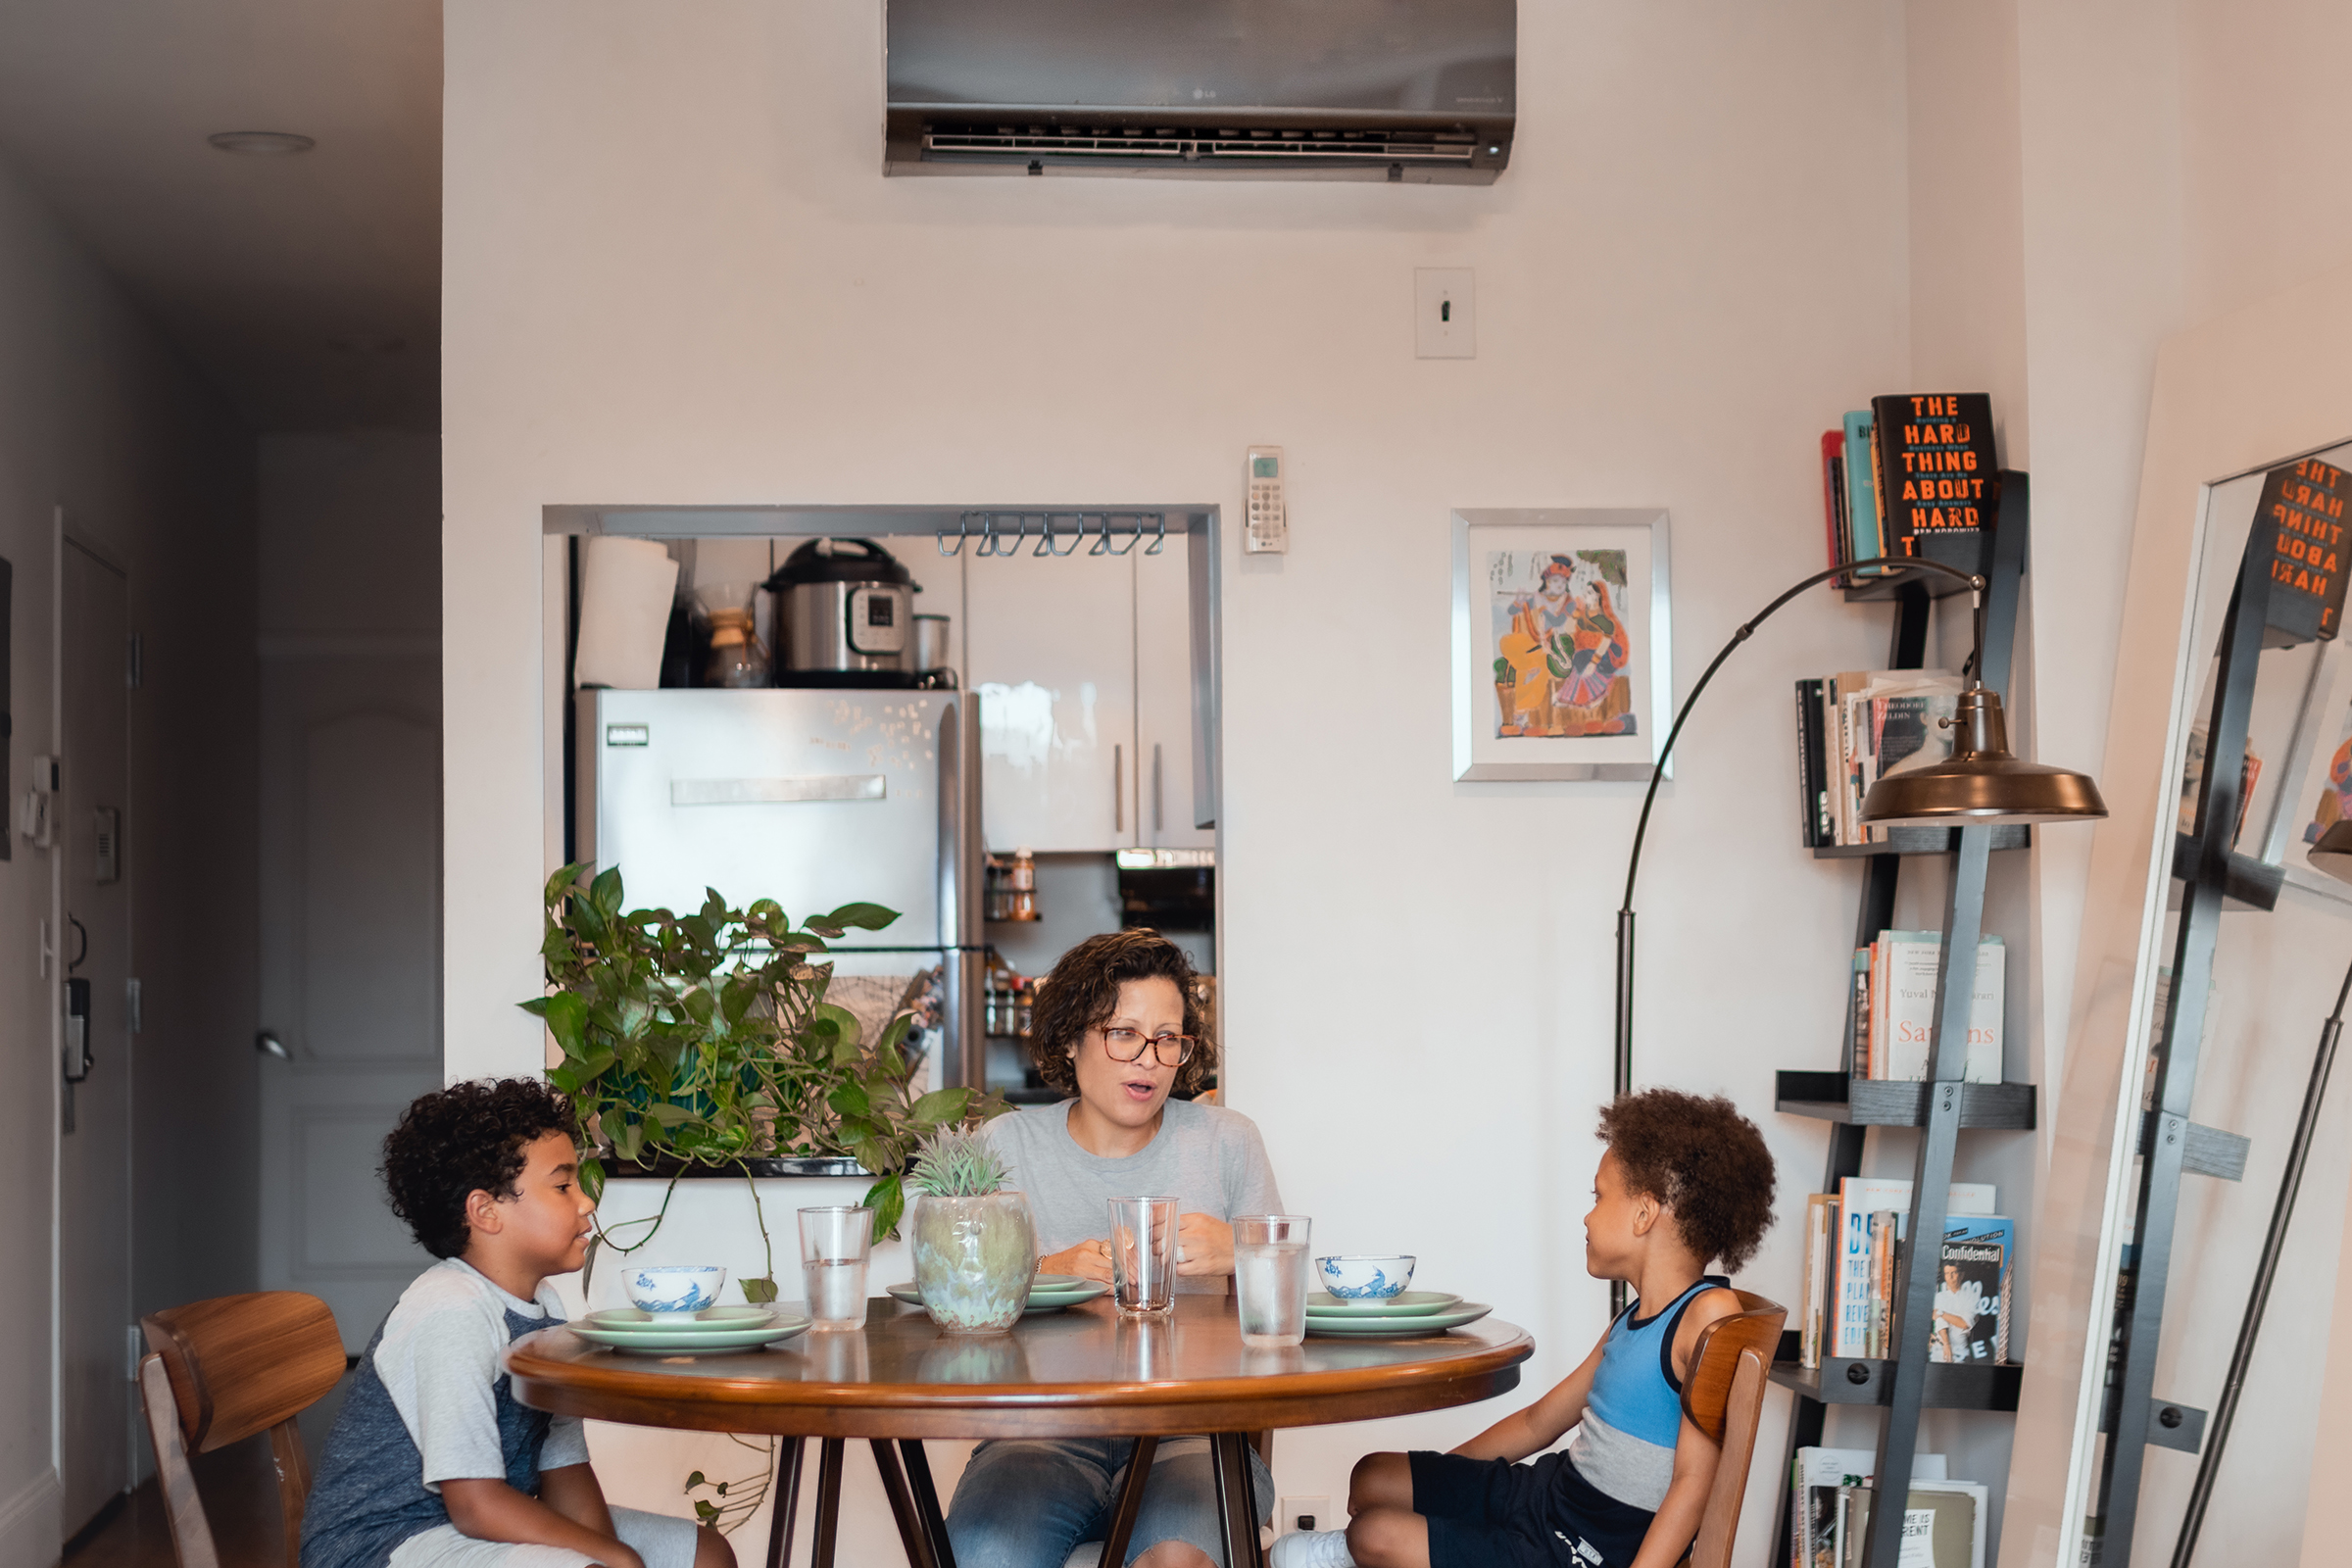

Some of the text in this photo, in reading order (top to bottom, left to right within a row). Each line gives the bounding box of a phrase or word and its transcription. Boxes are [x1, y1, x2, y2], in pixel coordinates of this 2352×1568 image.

[1911, 396, 1958, 416] THE
[1904, 423, 1971, 444] HARD
[1901, 451, 1978, 472] THING
[1902, 478, 1984, 500] ABOUT
[1911, 507, 1980, 527] HARD
[1900, 989, 1928, 999] Yuval
[1941, 1245, 2000, 1262] Confidential
[1845, 1304, 1869, 1322] REVE
[1902, 1525, 1930, 1537] RENT
